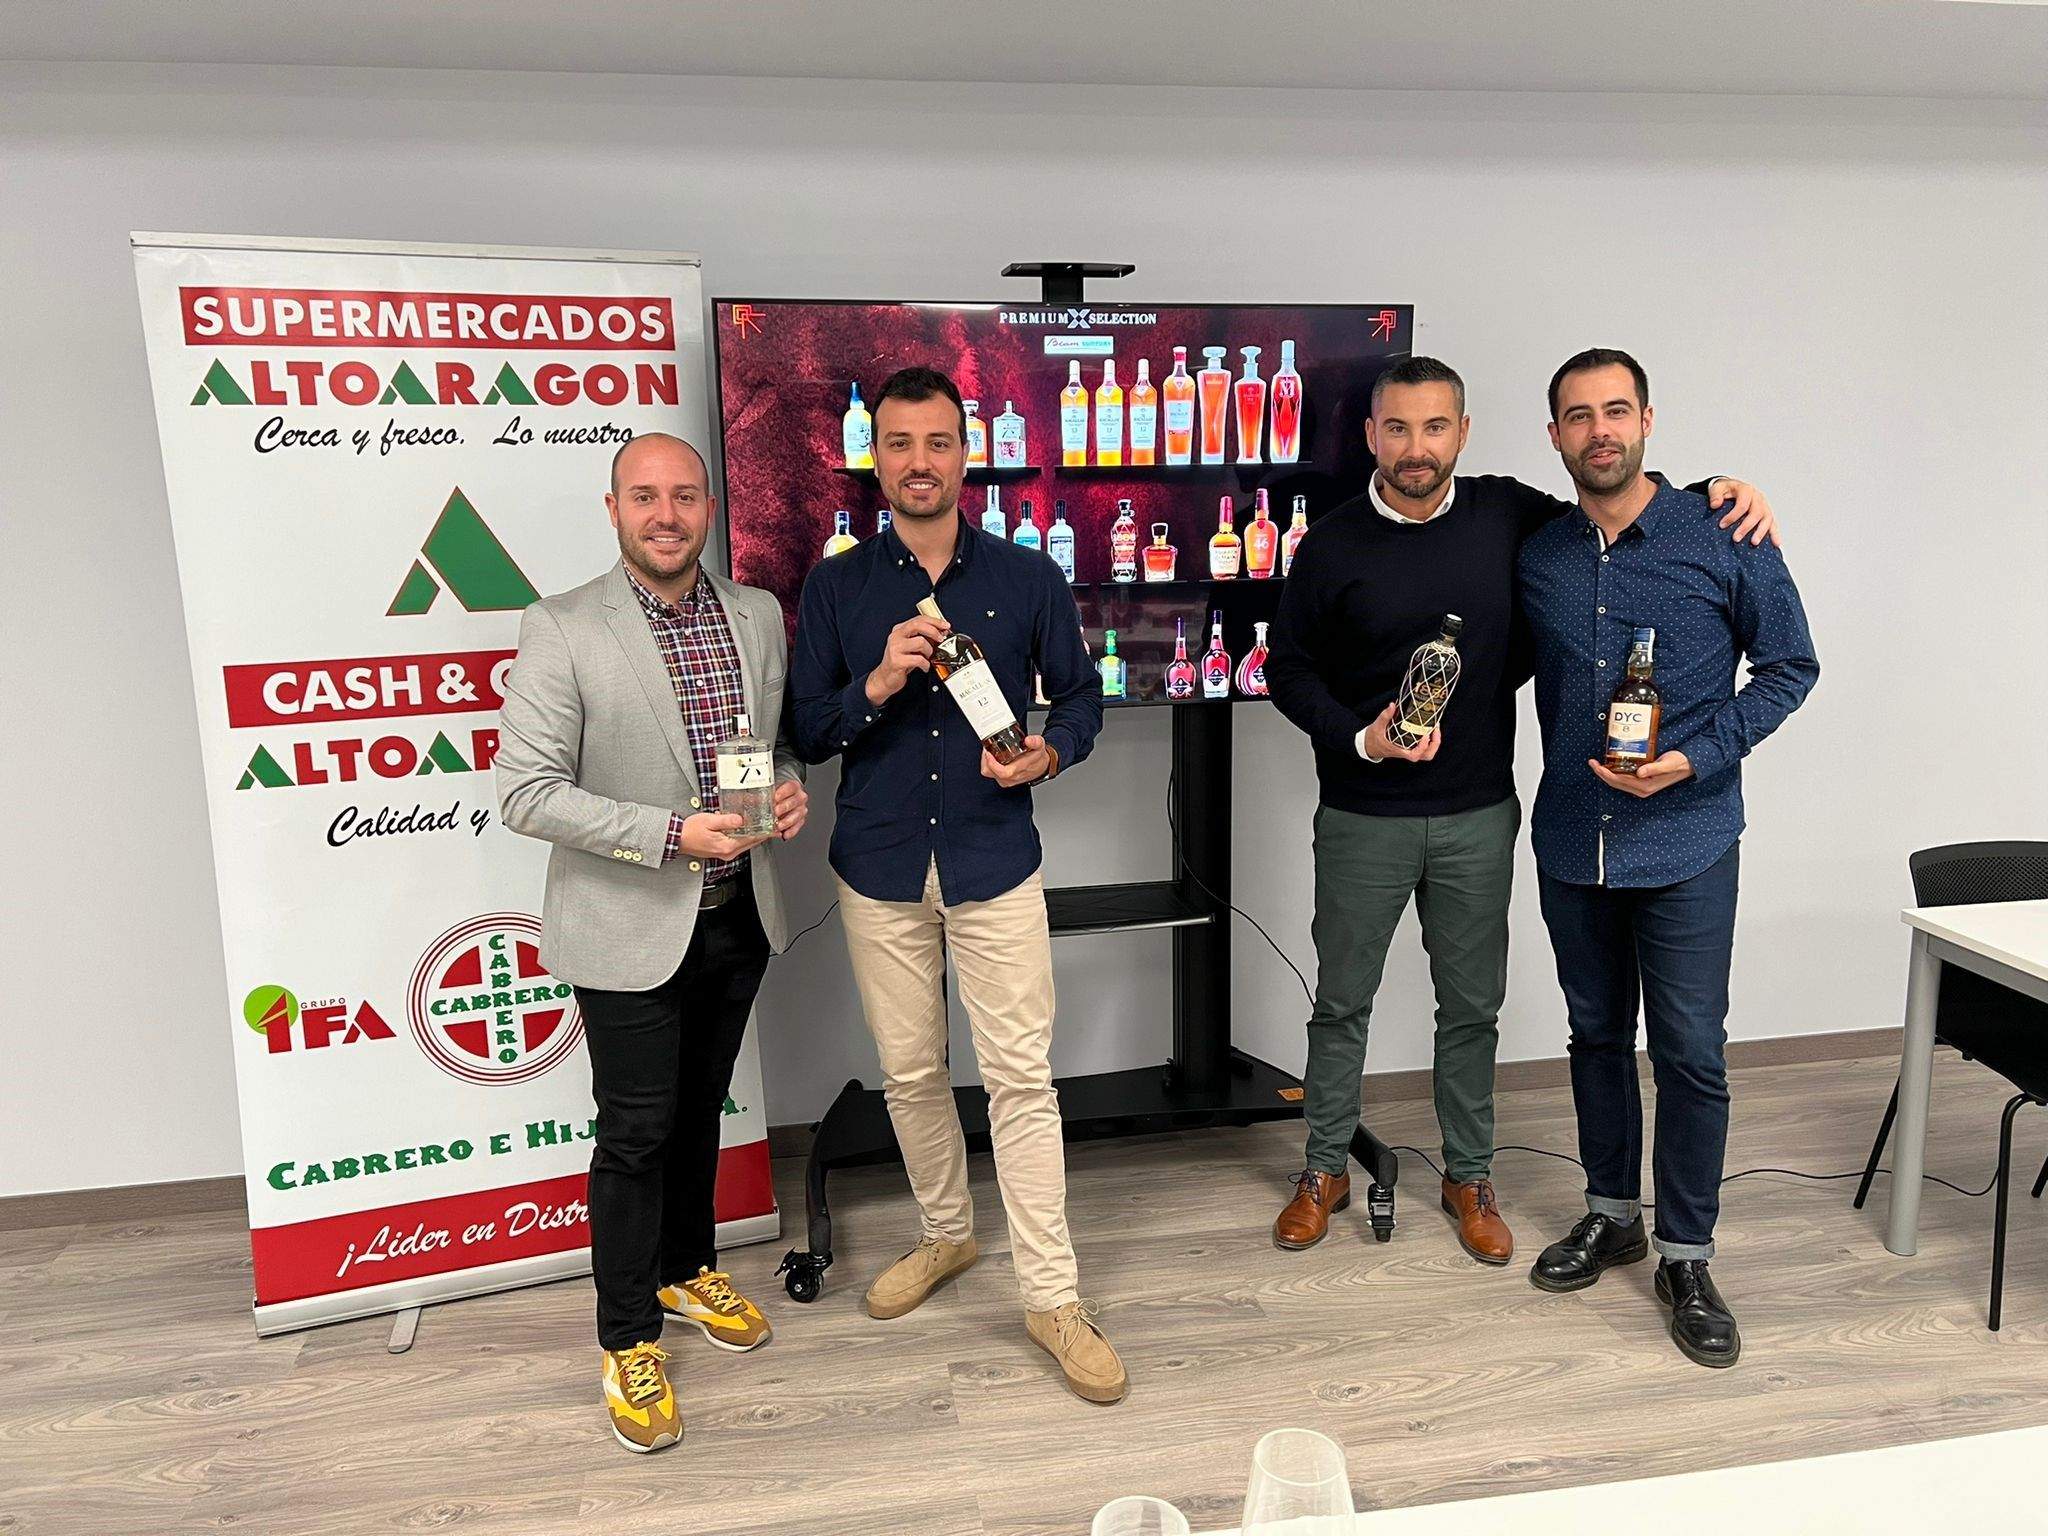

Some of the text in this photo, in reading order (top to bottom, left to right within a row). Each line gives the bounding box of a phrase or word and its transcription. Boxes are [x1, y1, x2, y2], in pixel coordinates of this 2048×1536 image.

[193, 296, 667, 342] SUPERMERCADOS
[999, 311, 1069, 325] PREMIUM
[1088, 312, 1158, 325] SELECTION
[190, 356, 680, 406] ALTOARAGON
[254, 414, 634, 457] Cerca y fresco. Lo nuestro
[261, 662, 423, 716] CASH
[436, 662, 480, 704] &
[1614, 711, 1642, 723] DYC
[236, 728, 501, 791] ALTOAR
[326, 800, 491, 848] Calidad y
[300, 997, 347, 1010] GRUPO
[430, 983, 573, 1016] CABRERO
[335, 1198, 590, 1278] ¡Lider en Distr
